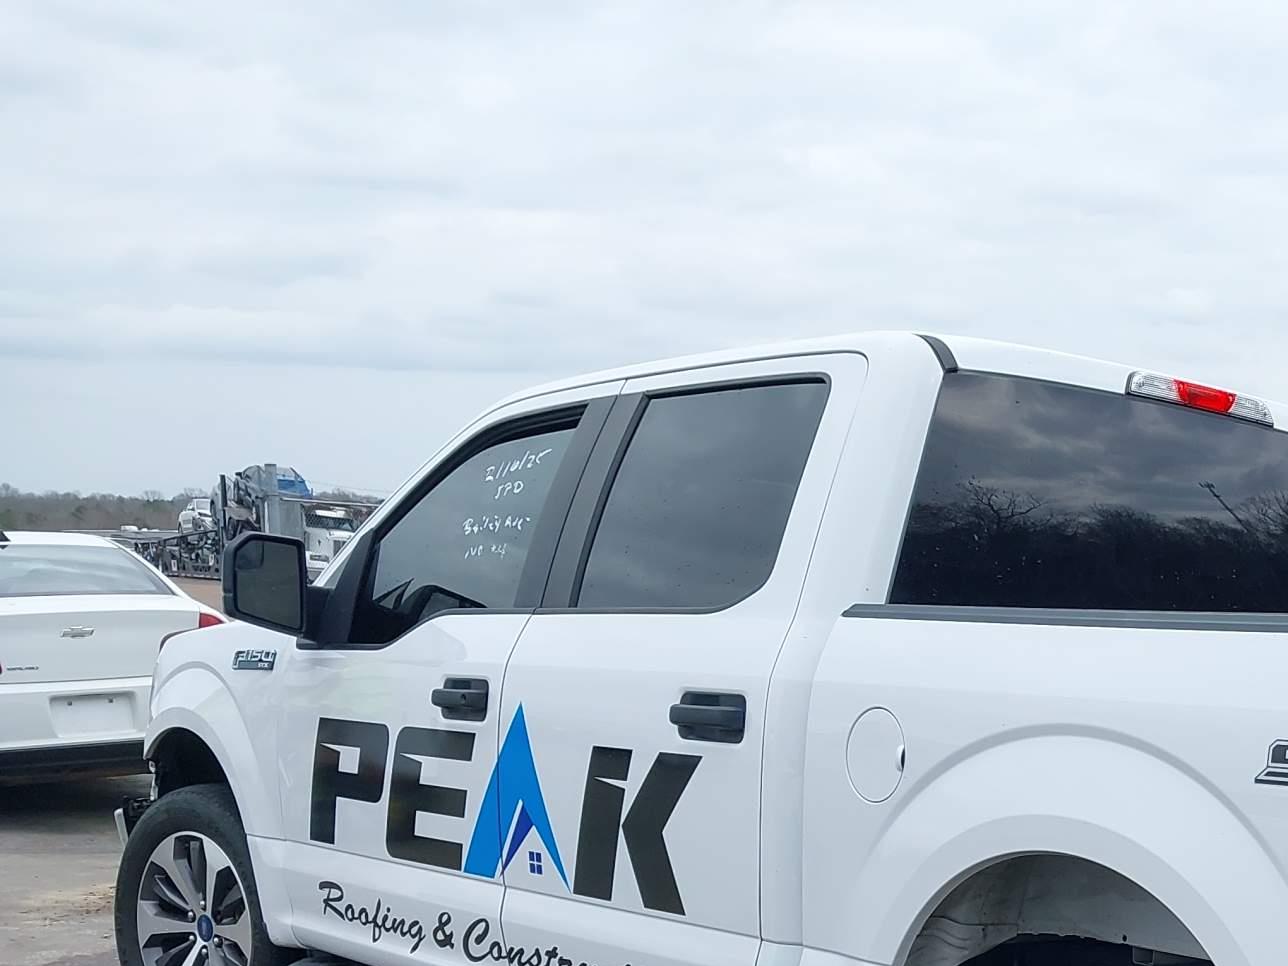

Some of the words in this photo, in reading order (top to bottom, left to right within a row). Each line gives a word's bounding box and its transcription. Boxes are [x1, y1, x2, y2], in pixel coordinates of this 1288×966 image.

[309, 701, 704, 917] PEAK
[317, 880, 427, 954] Roofing
[432, 911, 456, 949] &
